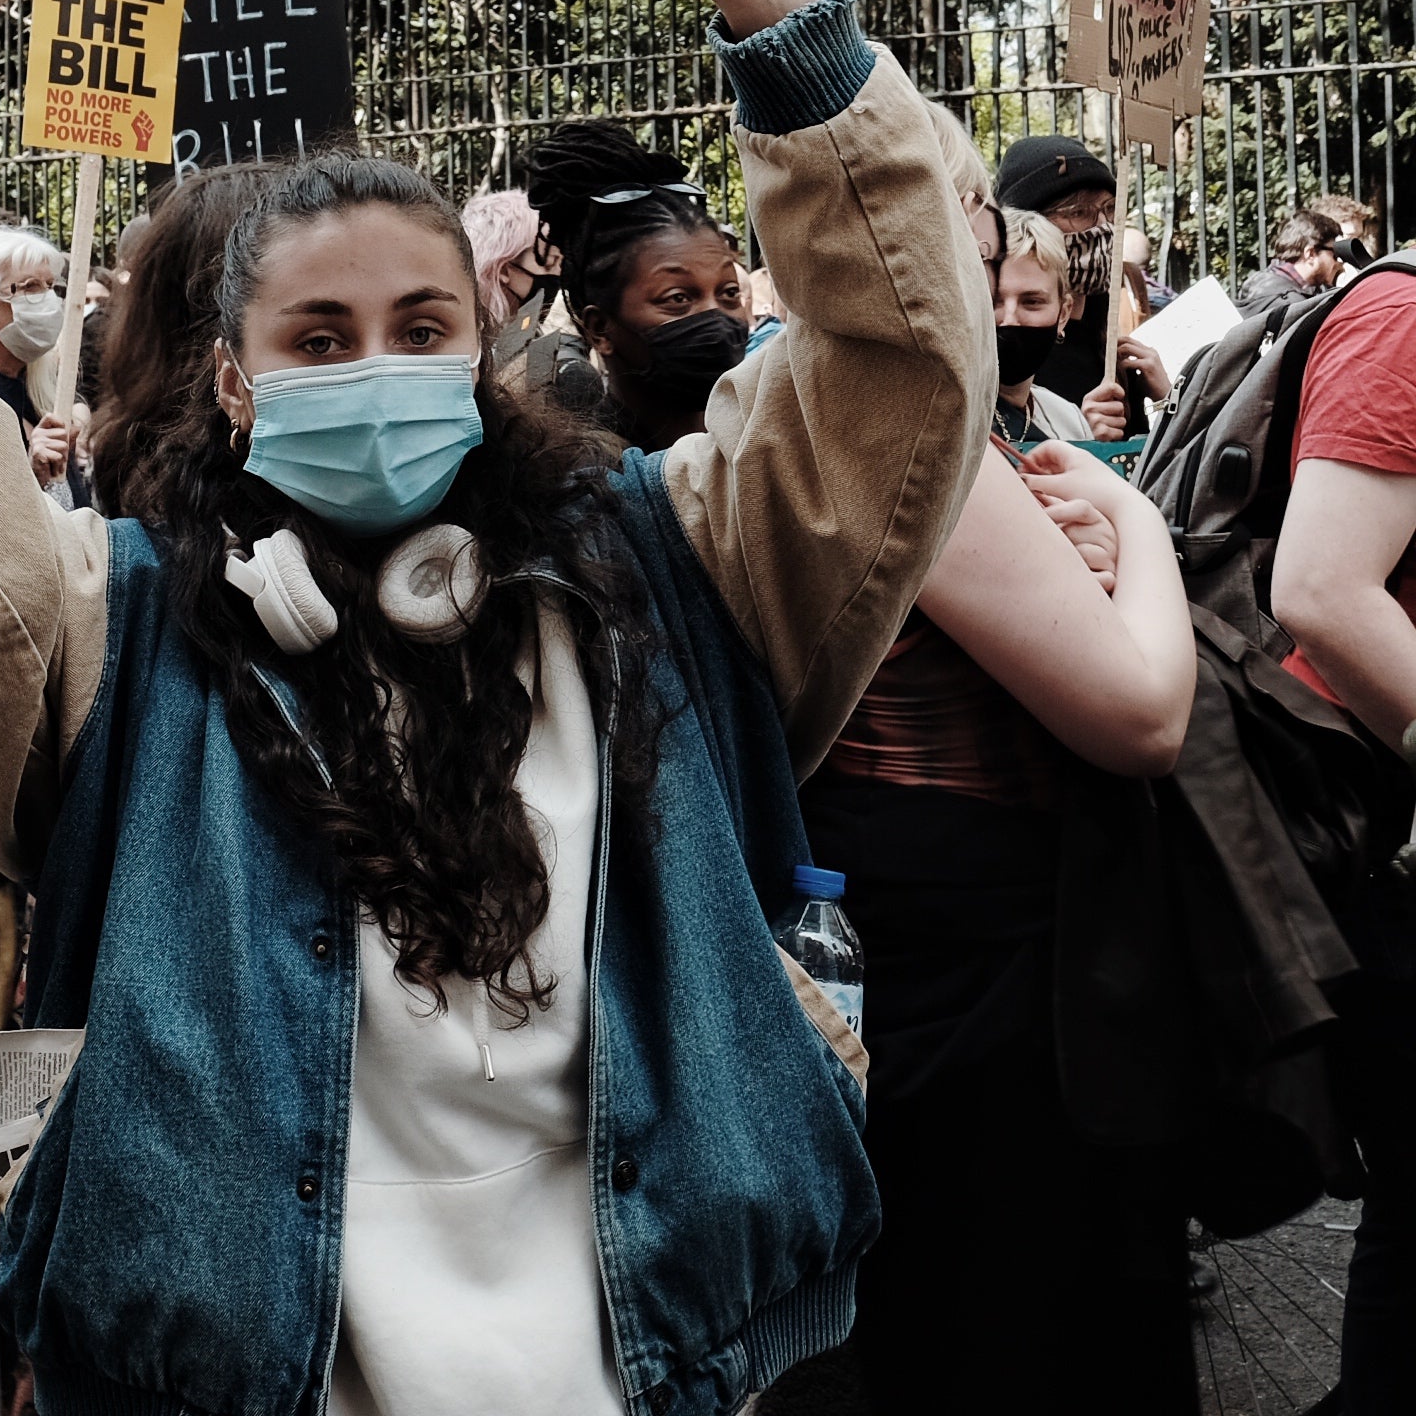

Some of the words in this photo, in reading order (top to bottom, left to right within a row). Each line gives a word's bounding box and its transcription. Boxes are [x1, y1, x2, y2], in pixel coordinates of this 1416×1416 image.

[1138, 14, 1172, 42] POLICE
[47, 39, 157, 99] BILL
[182, 41, 287, 102] THE
[1141, 33, 1184, 87] POWERS
[46, 88, 74, 105] NO
[80, 92, 132, 114] MORE
[45, 106, 113, 129] POLICE
[44, 123, 122, 148] POWERS
